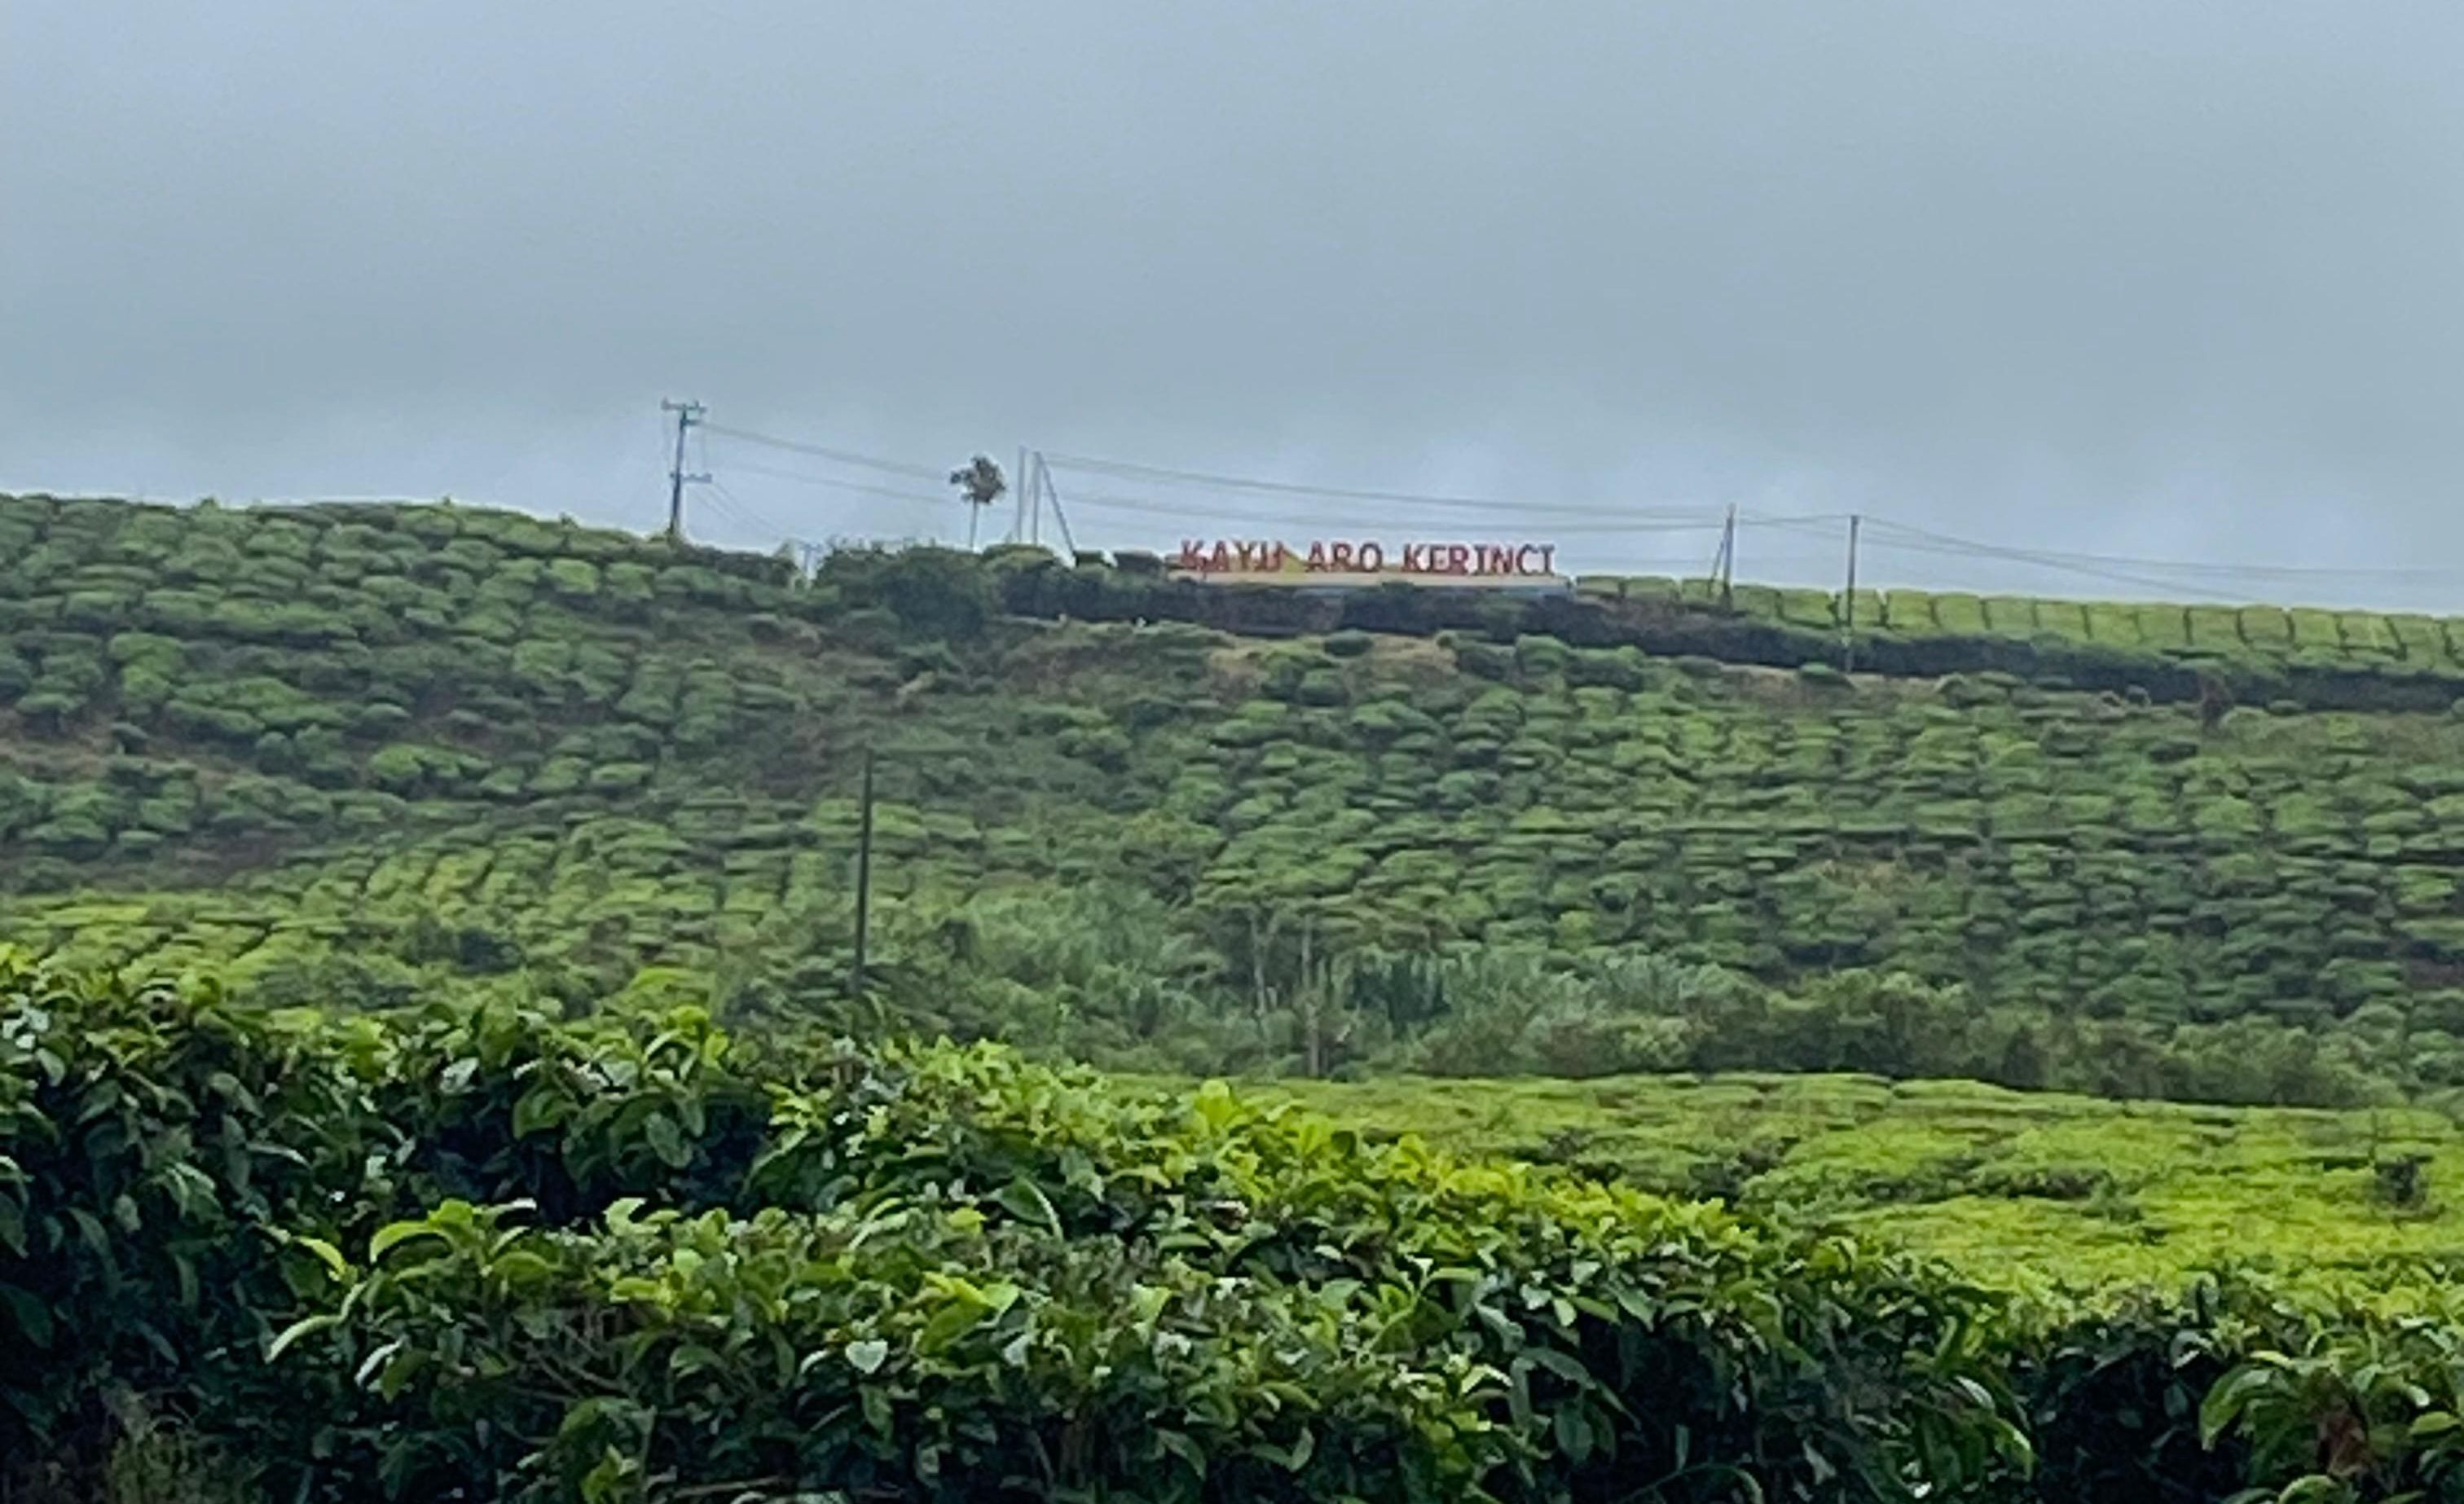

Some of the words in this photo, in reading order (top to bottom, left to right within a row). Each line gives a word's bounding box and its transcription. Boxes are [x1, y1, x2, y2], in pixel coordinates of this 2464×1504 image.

[1181, 540, 1284, 572] KAYU
[1305, 541, 1383, 573] ARO
[1401, 543, 1555, 576] KERINCI
